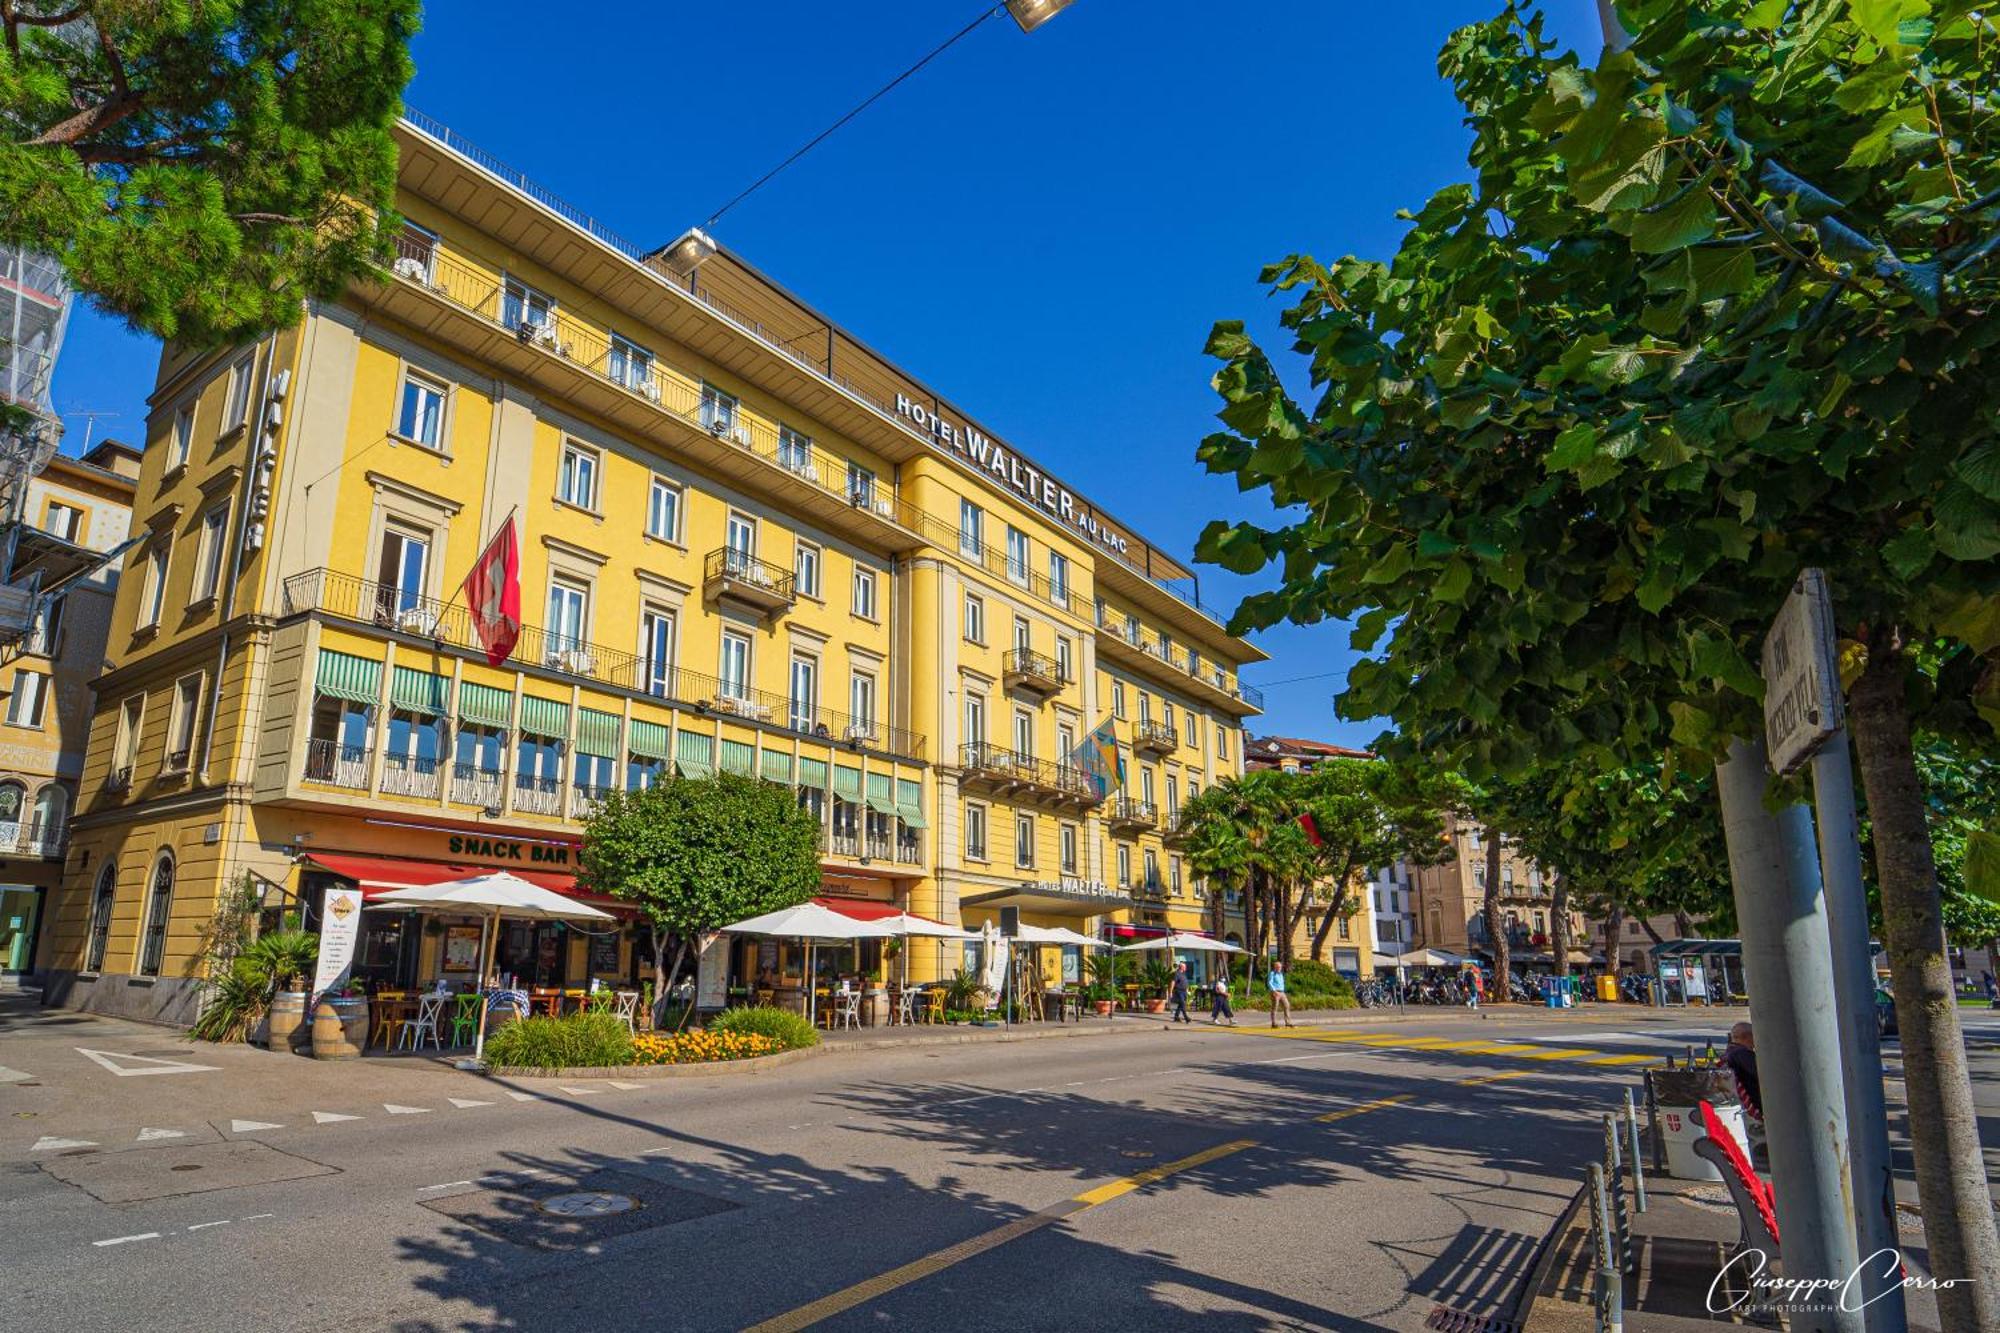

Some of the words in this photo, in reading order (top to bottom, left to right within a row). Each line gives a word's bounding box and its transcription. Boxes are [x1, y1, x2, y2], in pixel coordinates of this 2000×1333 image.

[896, 392, 963, 449] HOTEL
[964, 426, 1073, 521] WALTER
[1078, 512, 1097, 534] AU
[1102, 527, 1128, 554] LAC
[449, 836, 521, 861] SNACK
[531, 844, 568, 865] BAR
[1062, 876, 1105, 897] WALTER
